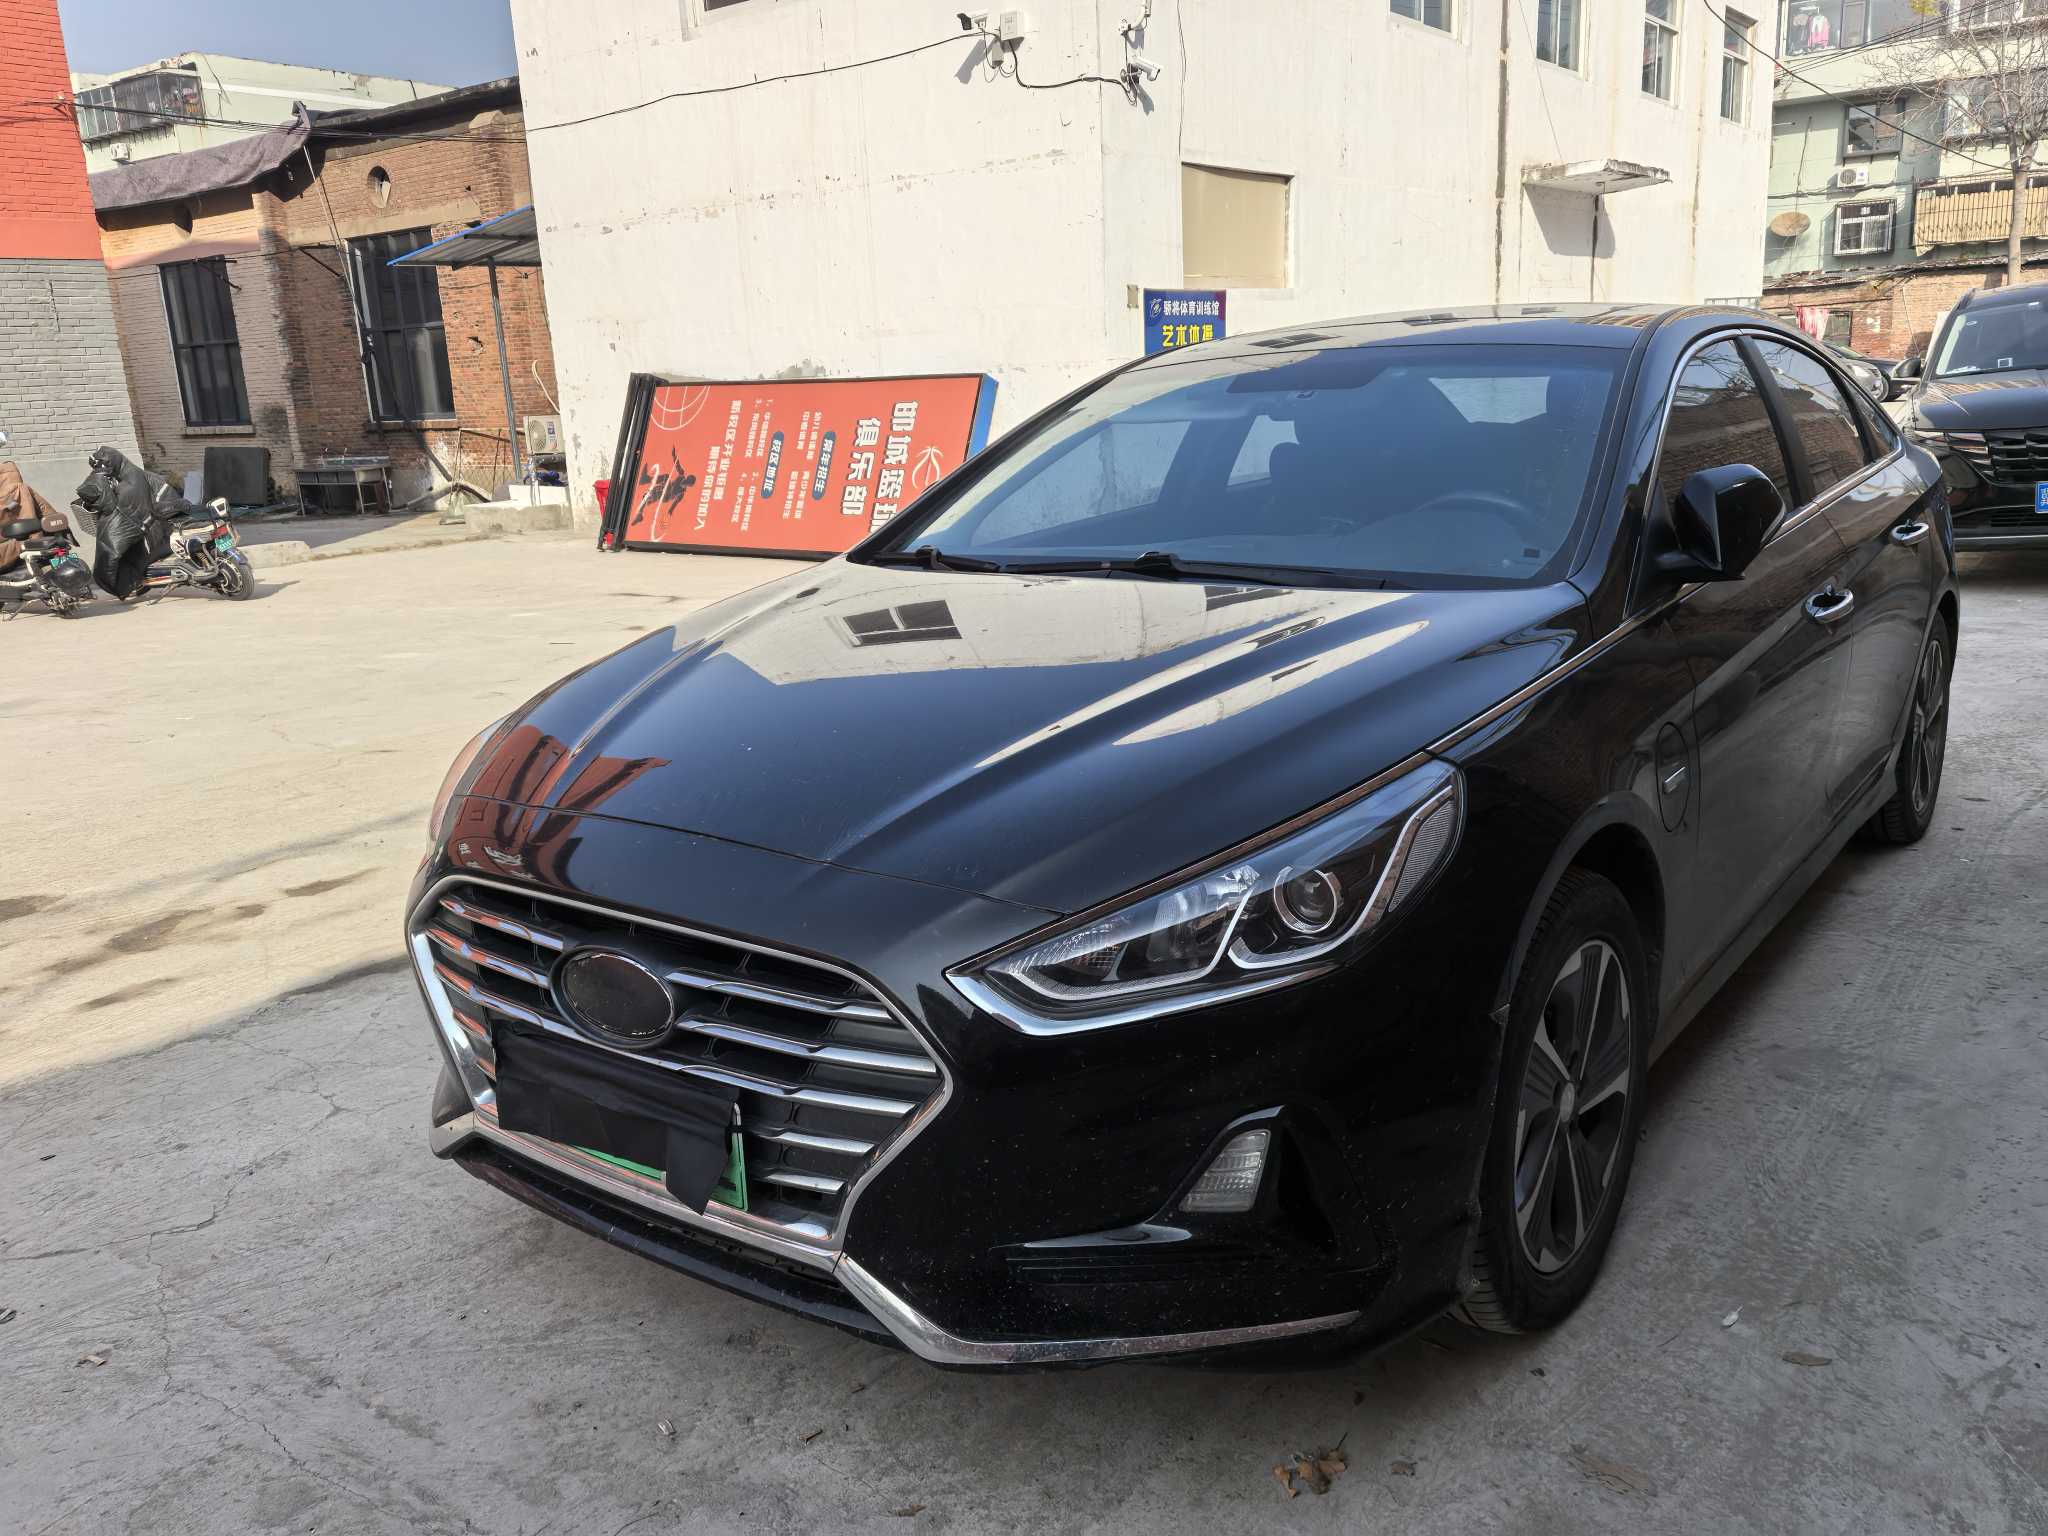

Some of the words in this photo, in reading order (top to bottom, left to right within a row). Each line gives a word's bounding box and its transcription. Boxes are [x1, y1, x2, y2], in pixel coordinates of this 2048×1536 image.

[693, 445, 721, 531] 期待你的加入
[762, 438, 784, 492] 校区地址
[812, 437, 835, 492] 常年招生
[840, 417, 882, 516] 俱乐部
